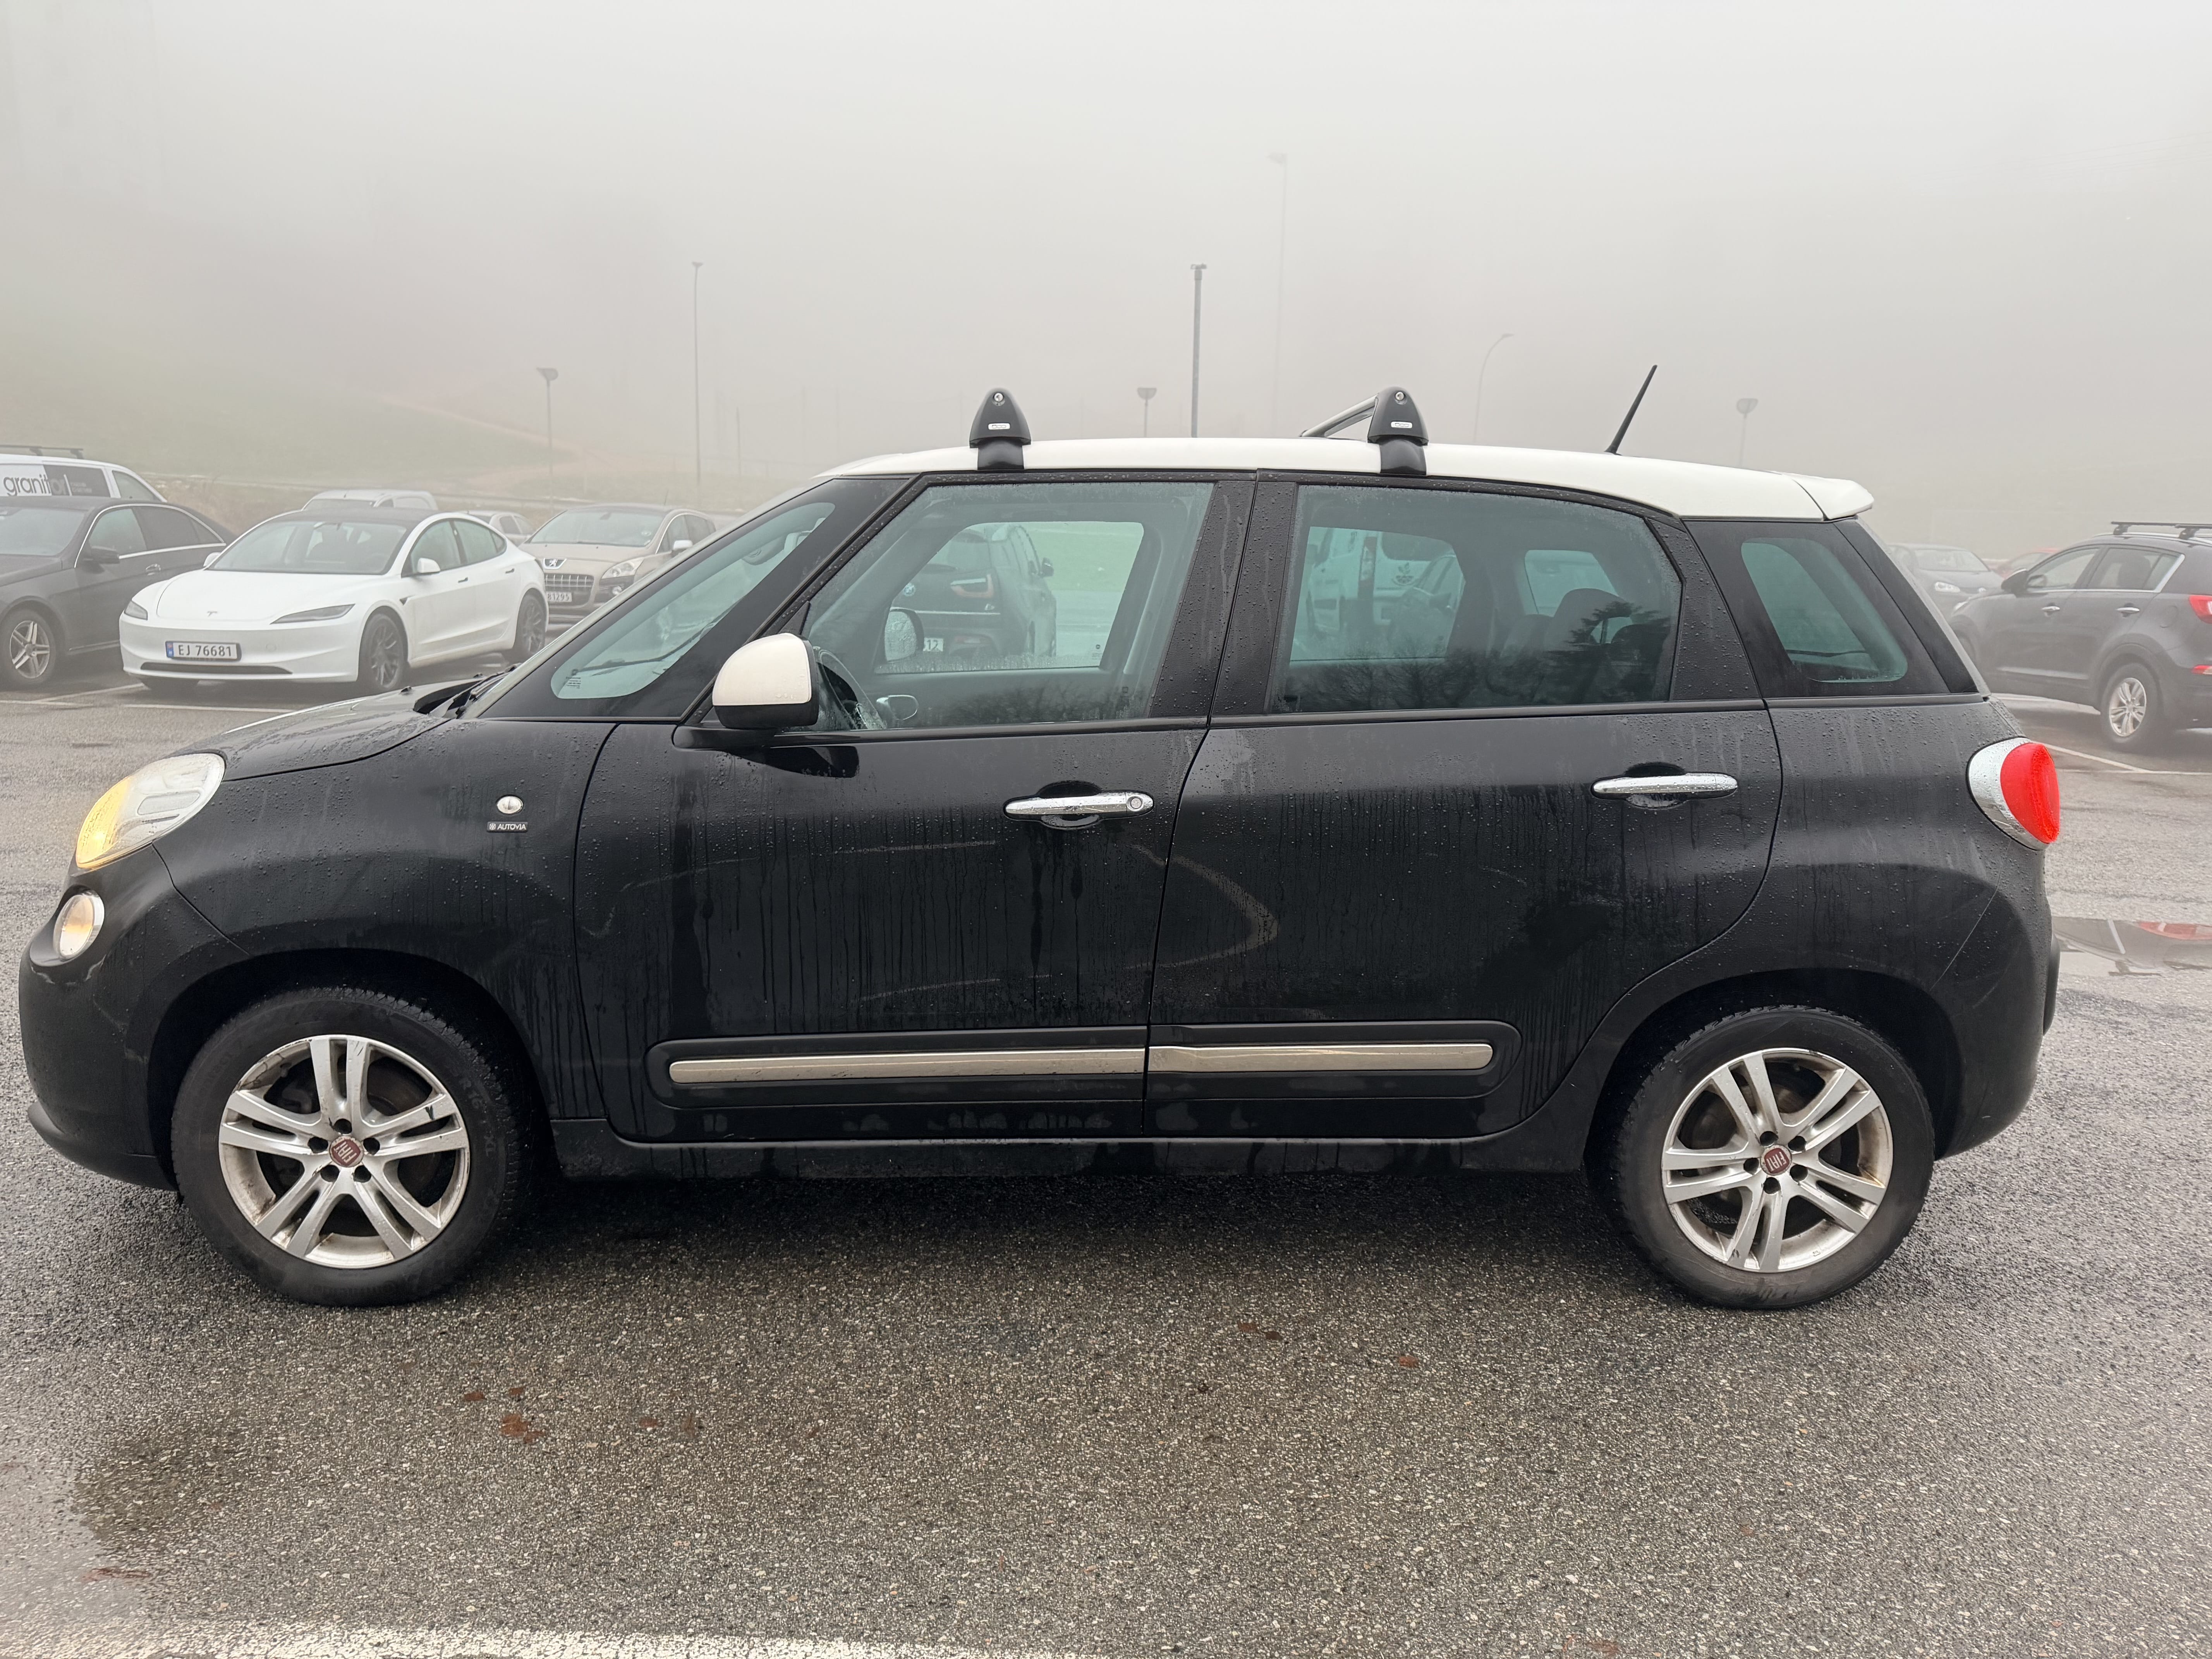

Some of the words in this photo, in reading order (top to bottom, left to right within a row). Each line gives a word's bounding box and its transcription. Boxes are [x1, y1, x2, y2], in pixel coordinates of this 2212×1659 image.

[178, 644, 190, 655] EJ
[196, 645, 231, 656] 76681
[333, 1141, 357, 1163] FIAT
[1766, 1151, 1787, 1172] FIAT
